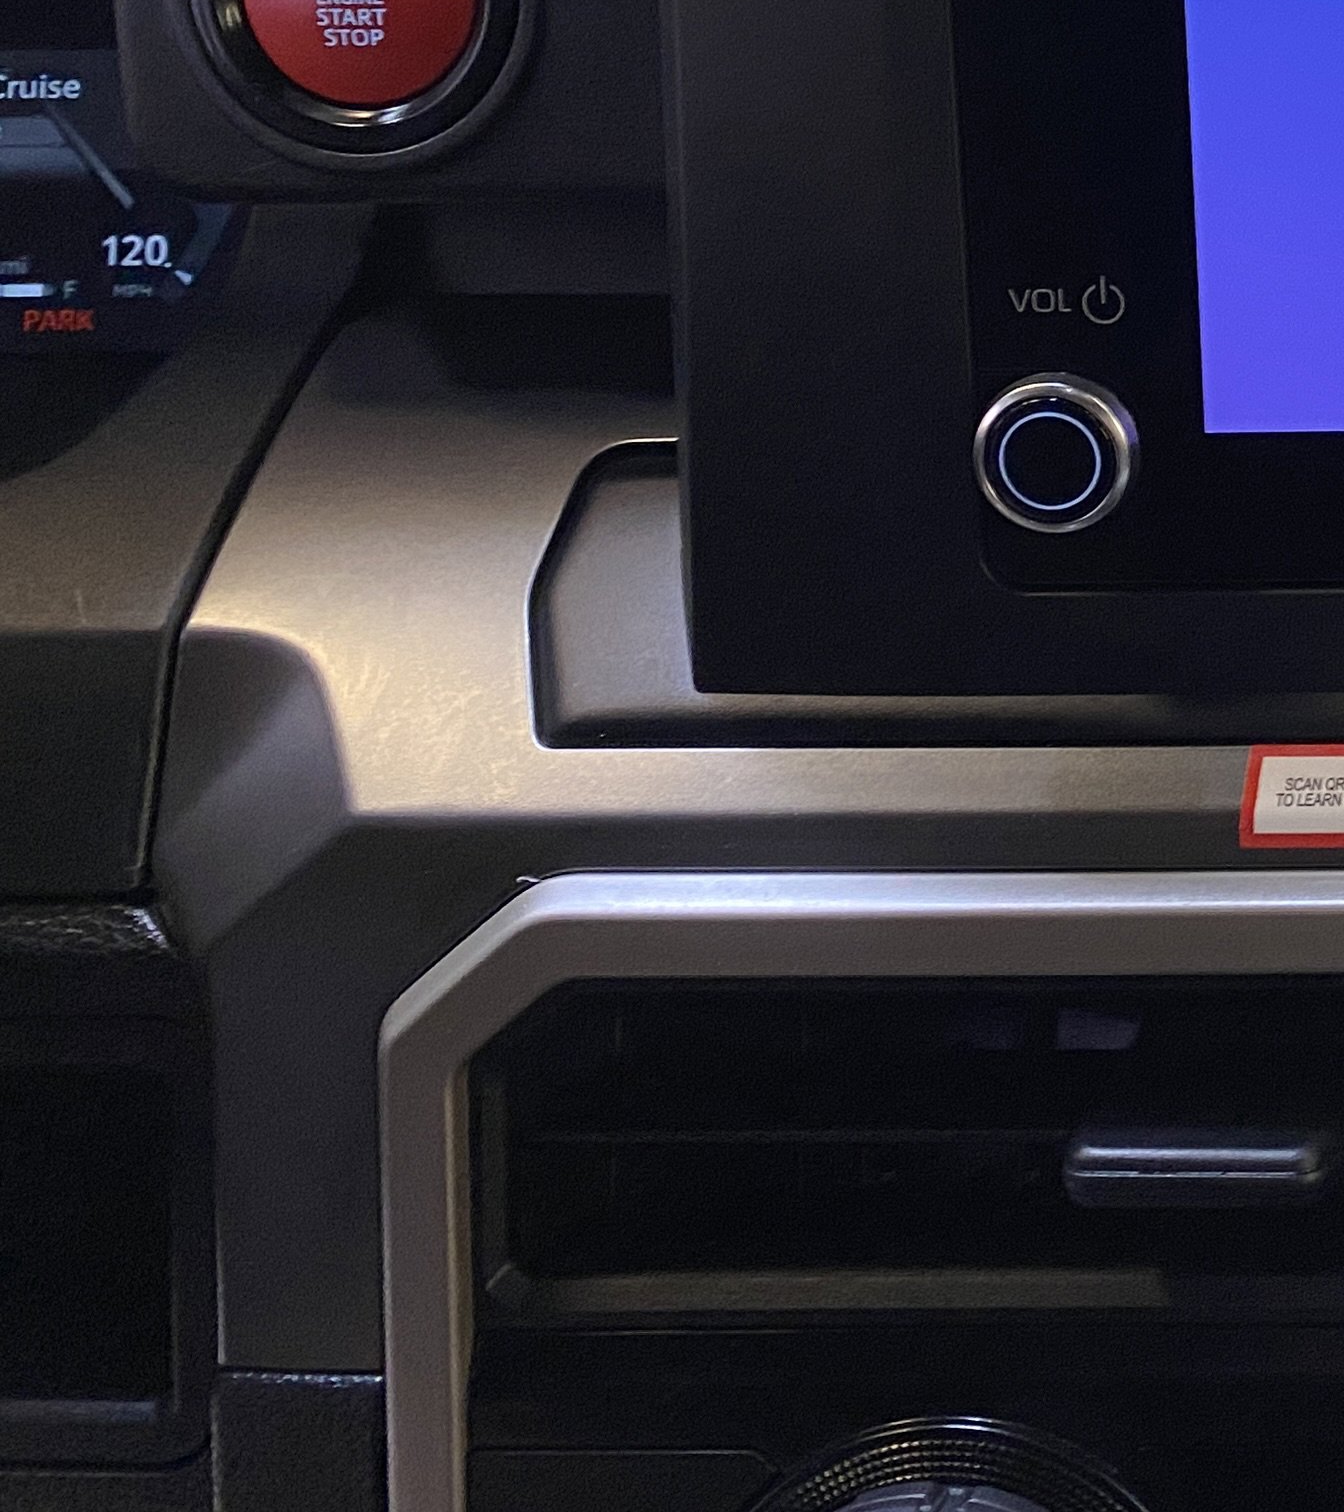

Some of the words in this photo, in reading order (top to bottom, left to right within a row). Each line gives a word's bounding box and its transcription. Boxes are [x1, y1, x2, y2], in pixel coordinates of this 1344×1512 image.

[315, 8, 387, 26] START
[323, 28, 385, 46] STOP
[102, 235, 169, 267] 120
[1007, 288, 1073, 313] VOL
[22, 309, 95, 332] PARK
[1284, 777, 1324, 791] SCAN
[1326, 777, 1344, 791] QR
[1276, 793, 1294, 807] TO
[1296, 793, 1342, 806] LEARN
